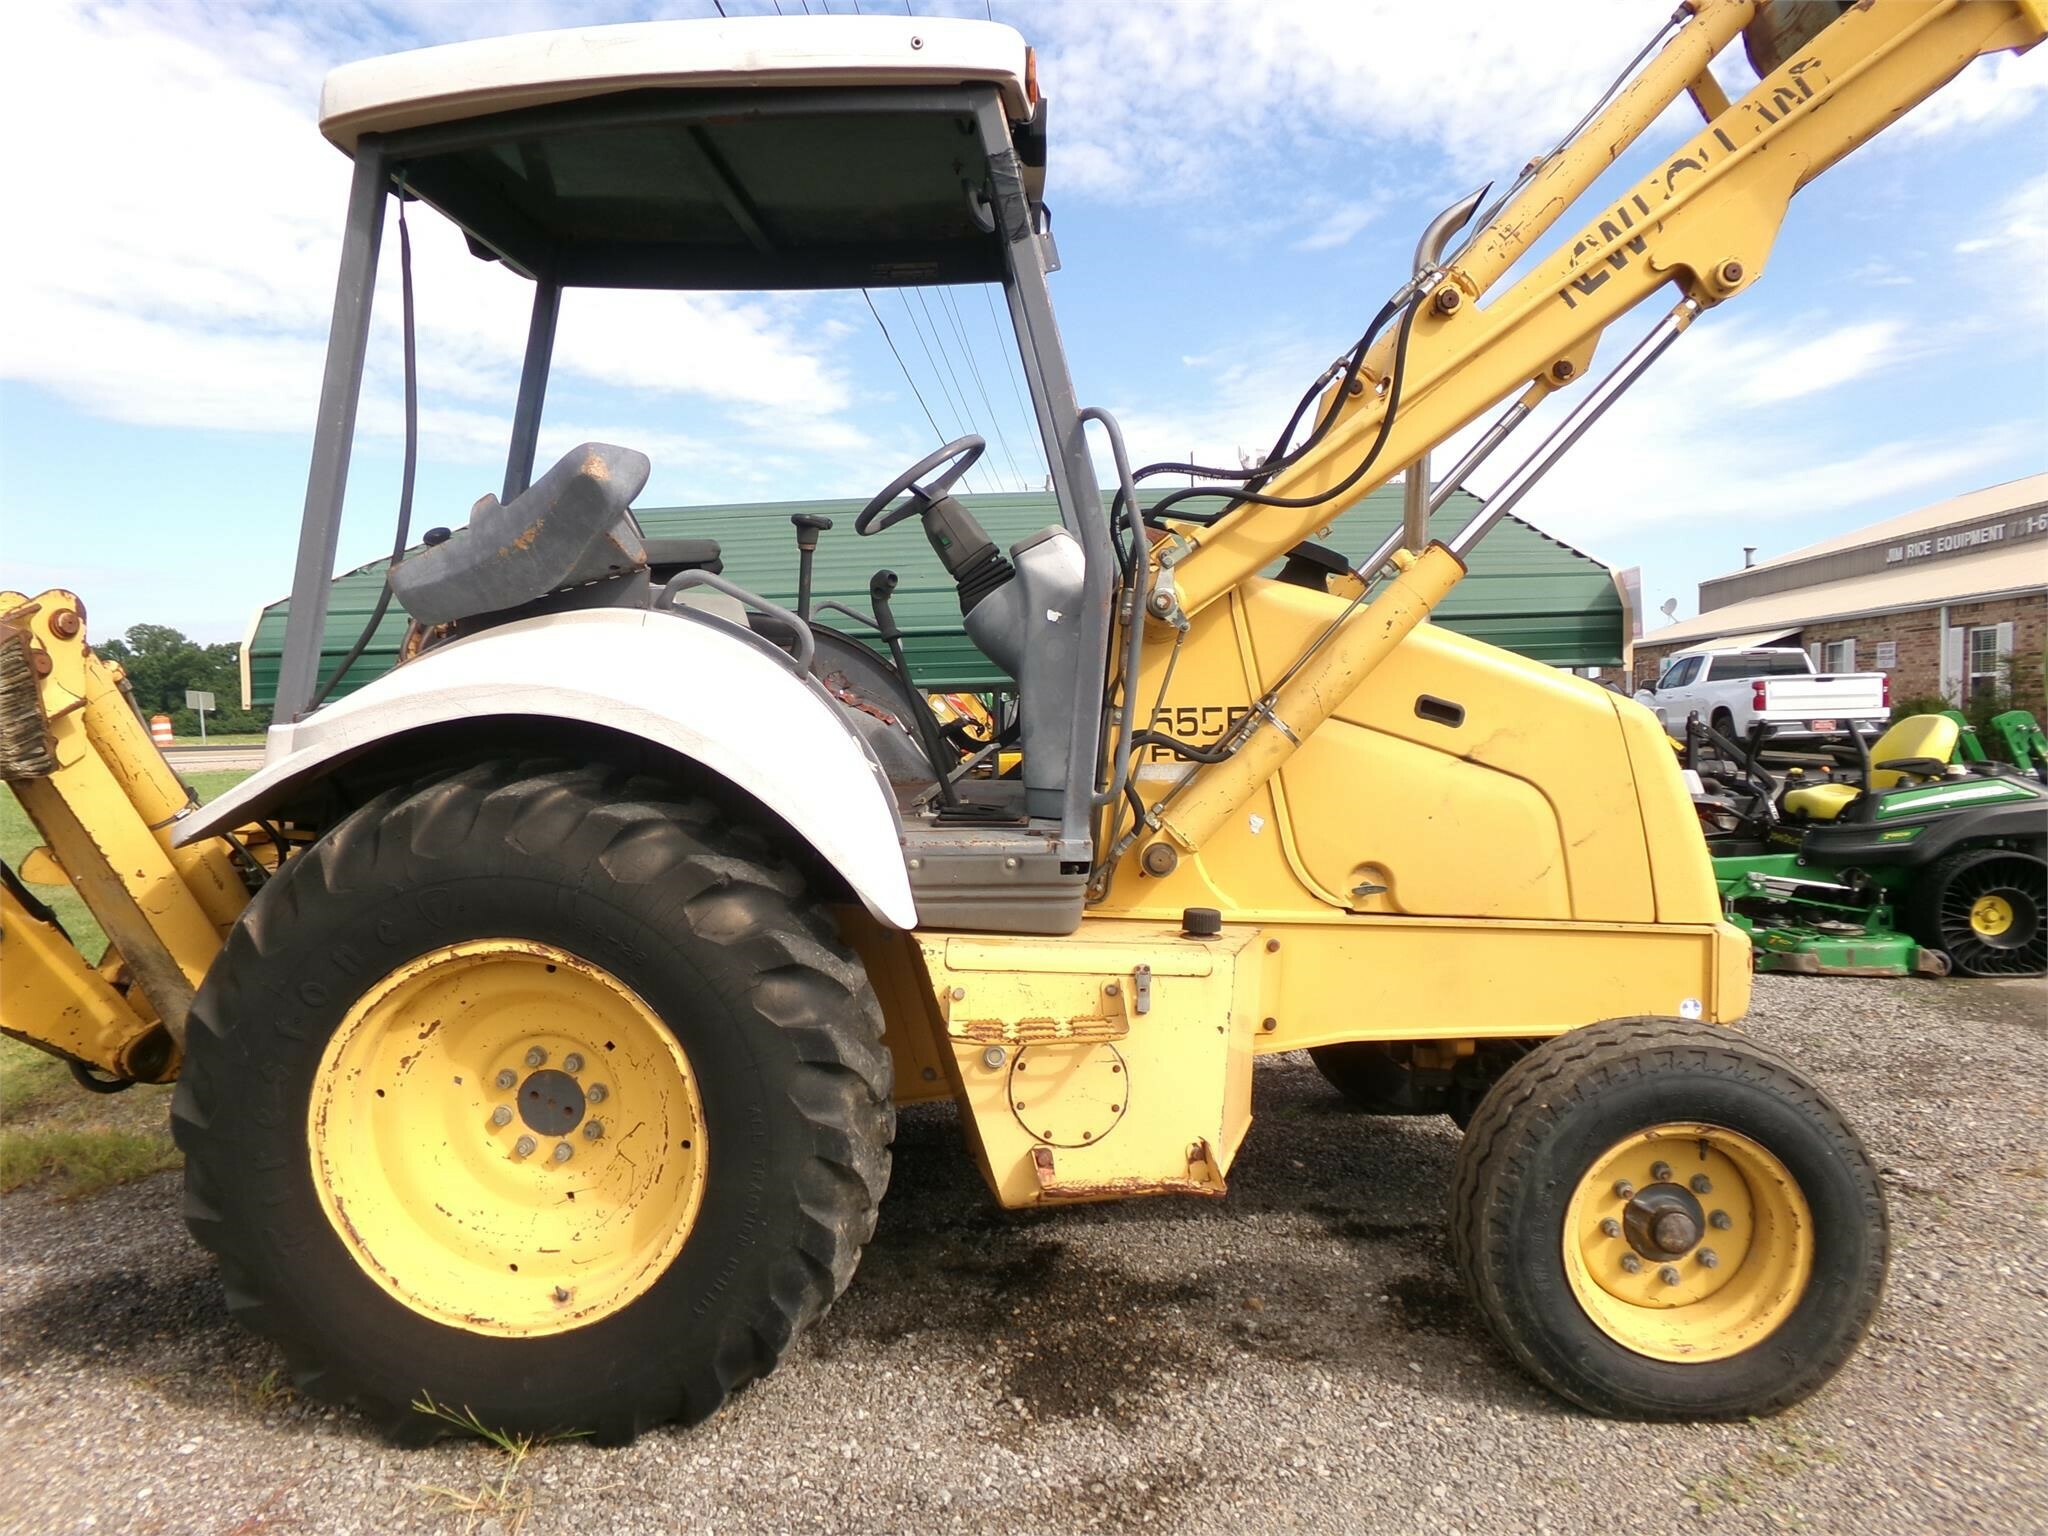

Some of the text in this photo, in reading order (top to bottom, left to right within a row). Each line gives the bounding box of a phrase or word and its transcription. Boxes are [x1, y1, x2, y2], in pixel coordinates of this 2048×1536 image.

[1887, 547, 1903, 563] JIM
[1907, 540, 1932, 558] RICE
[1938, 524, 2005, 552] EQUIPMENT
